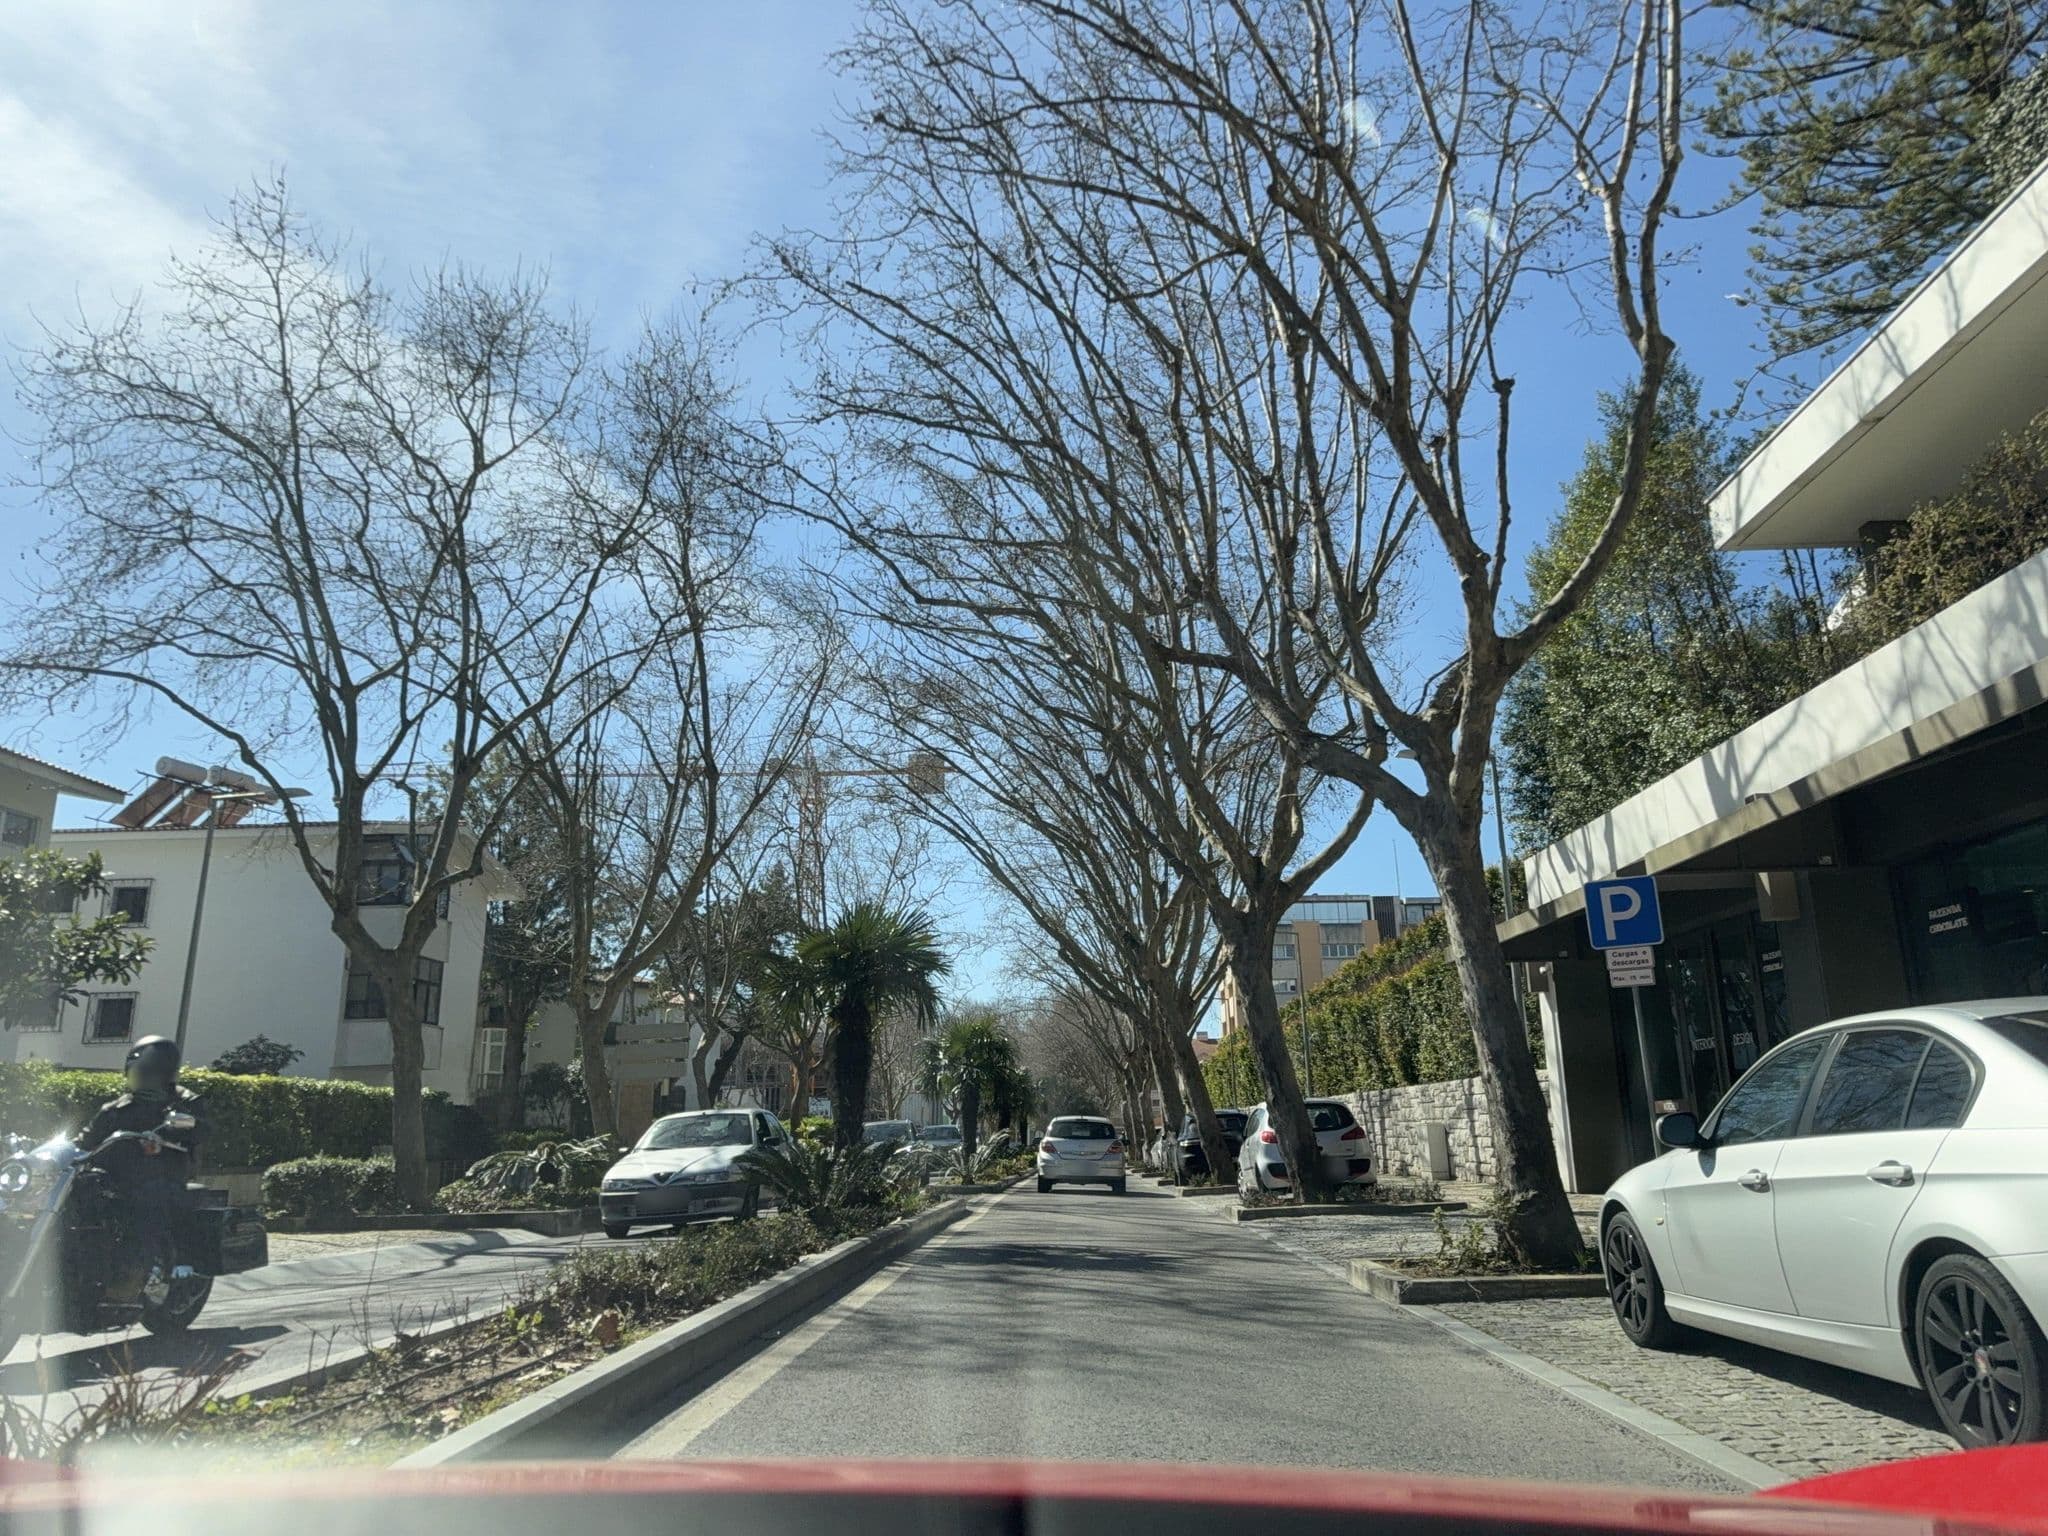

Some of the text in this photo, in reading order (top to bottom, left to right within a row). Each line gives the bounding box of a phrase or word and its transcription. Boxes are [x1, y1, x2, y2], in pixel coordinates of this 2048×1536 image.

[1599, 885, 1642, 941] P
[1611, 950, 1639, 959] Cargas
[1611, 958, 1649, 967] descargas
